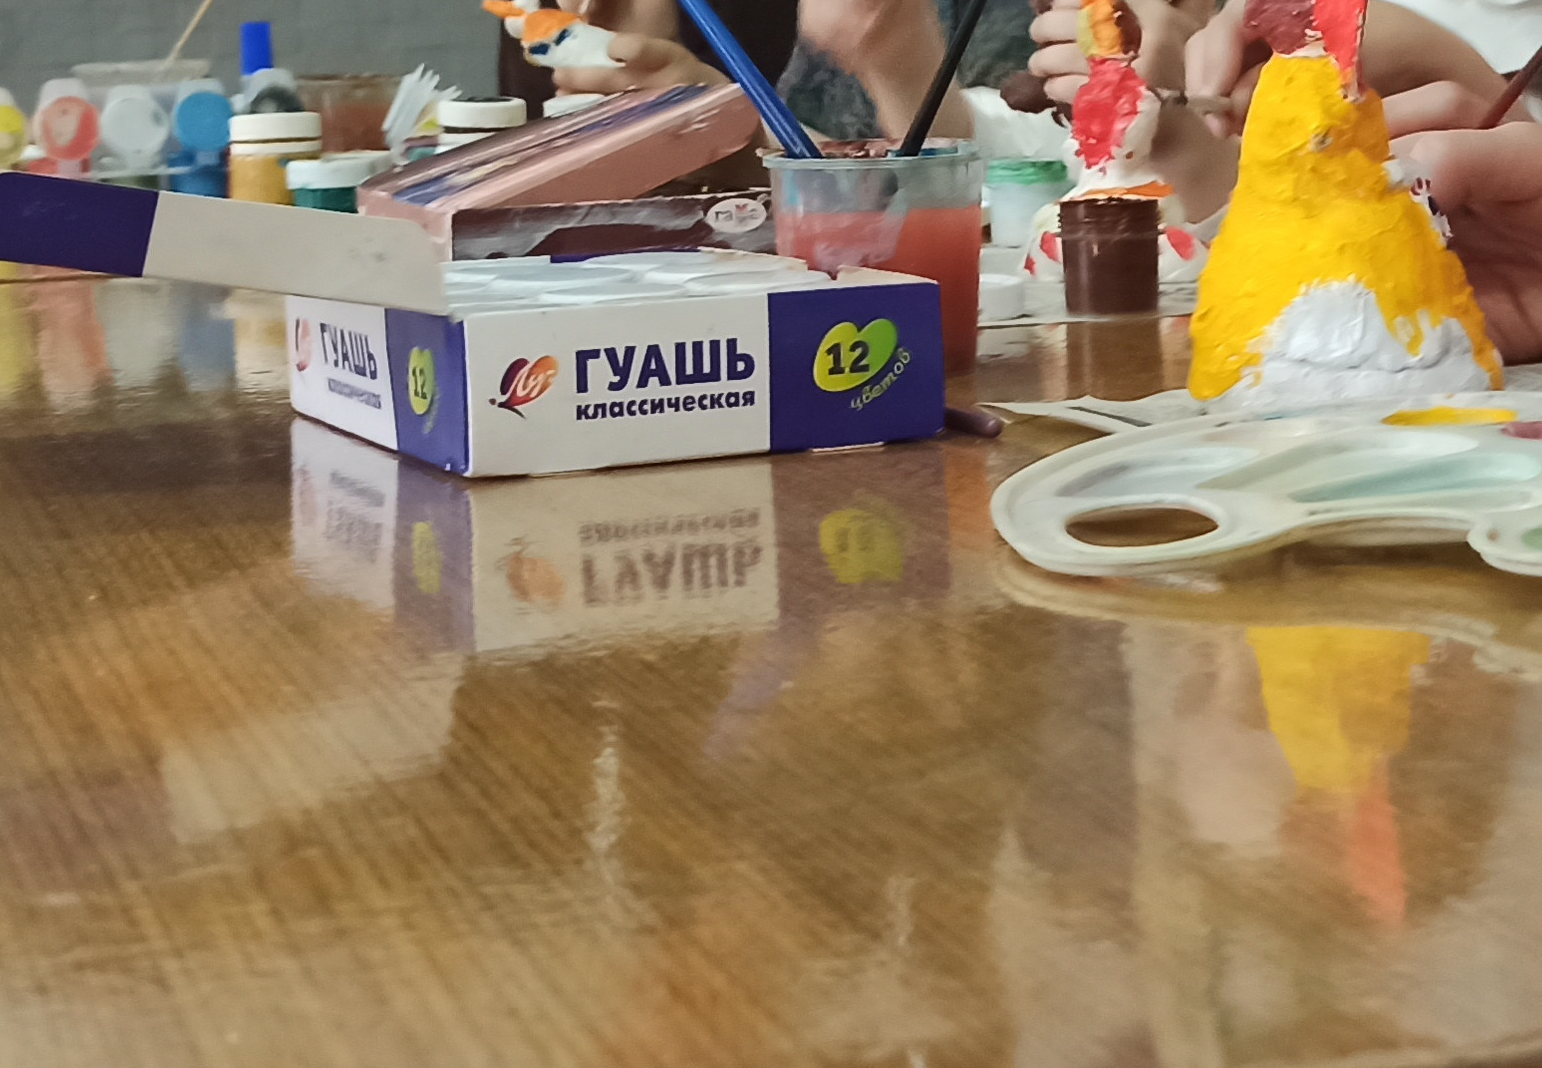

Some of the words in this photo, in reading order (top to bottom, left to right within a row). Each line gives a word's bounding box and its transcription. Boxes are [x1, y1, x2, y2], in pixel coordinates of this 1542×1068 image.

[320, 323, 378, 380] ГУАШЬ
[575, 337, 756, 394] ГУАШЬ
[825, 340, 870, 375] 12
[412, 365, 427, 399] 12
[576, 390, 756, 420] классическая
